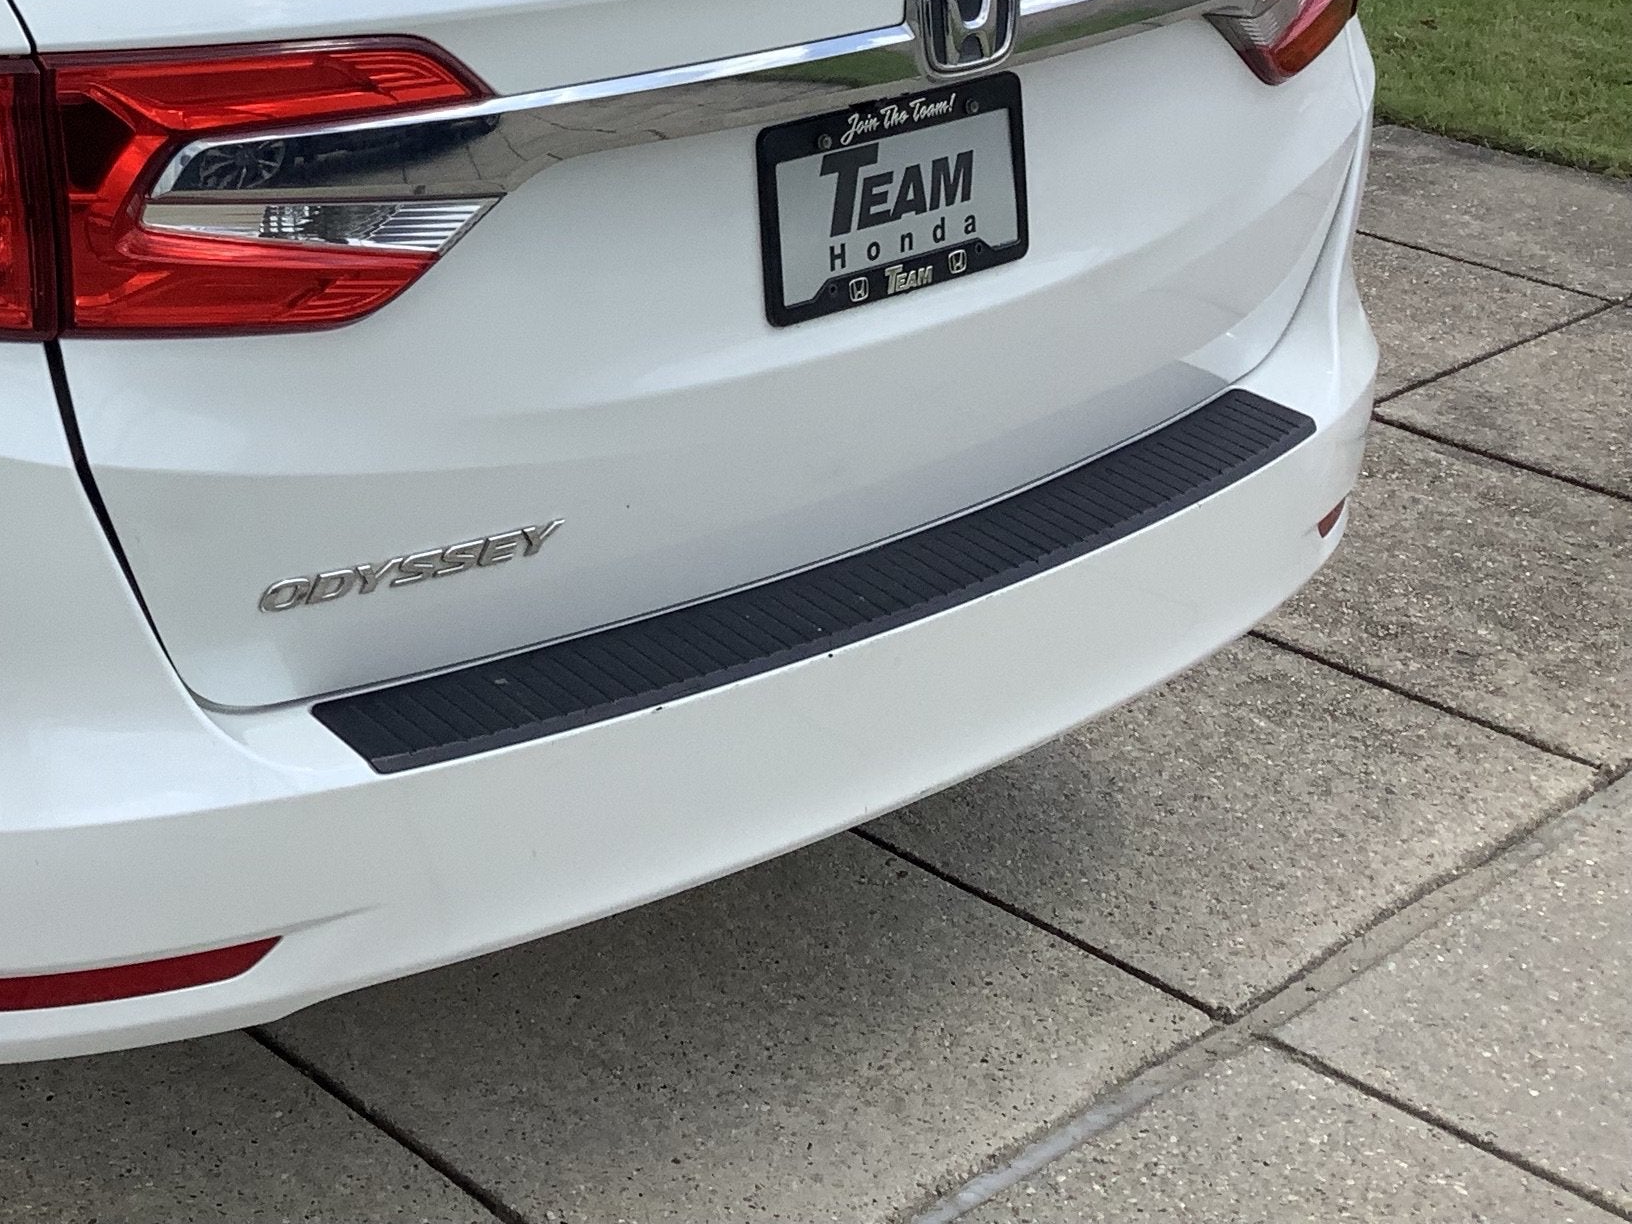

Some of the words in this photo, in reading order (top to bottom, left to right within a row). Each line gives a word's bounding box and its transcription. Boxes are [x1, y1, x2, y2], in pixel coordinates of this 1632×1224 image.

[840, 113, 880, 145] Join
[880, 104, 909, 129] The
[909, 92, 956, 122] Team!
[819, 142, 974, 238] TEAM
[829, 214, 977, 272] Honda
[884, 264, 934, 295] TEAM
[258, 518, 566, 613] ODYSSEY
